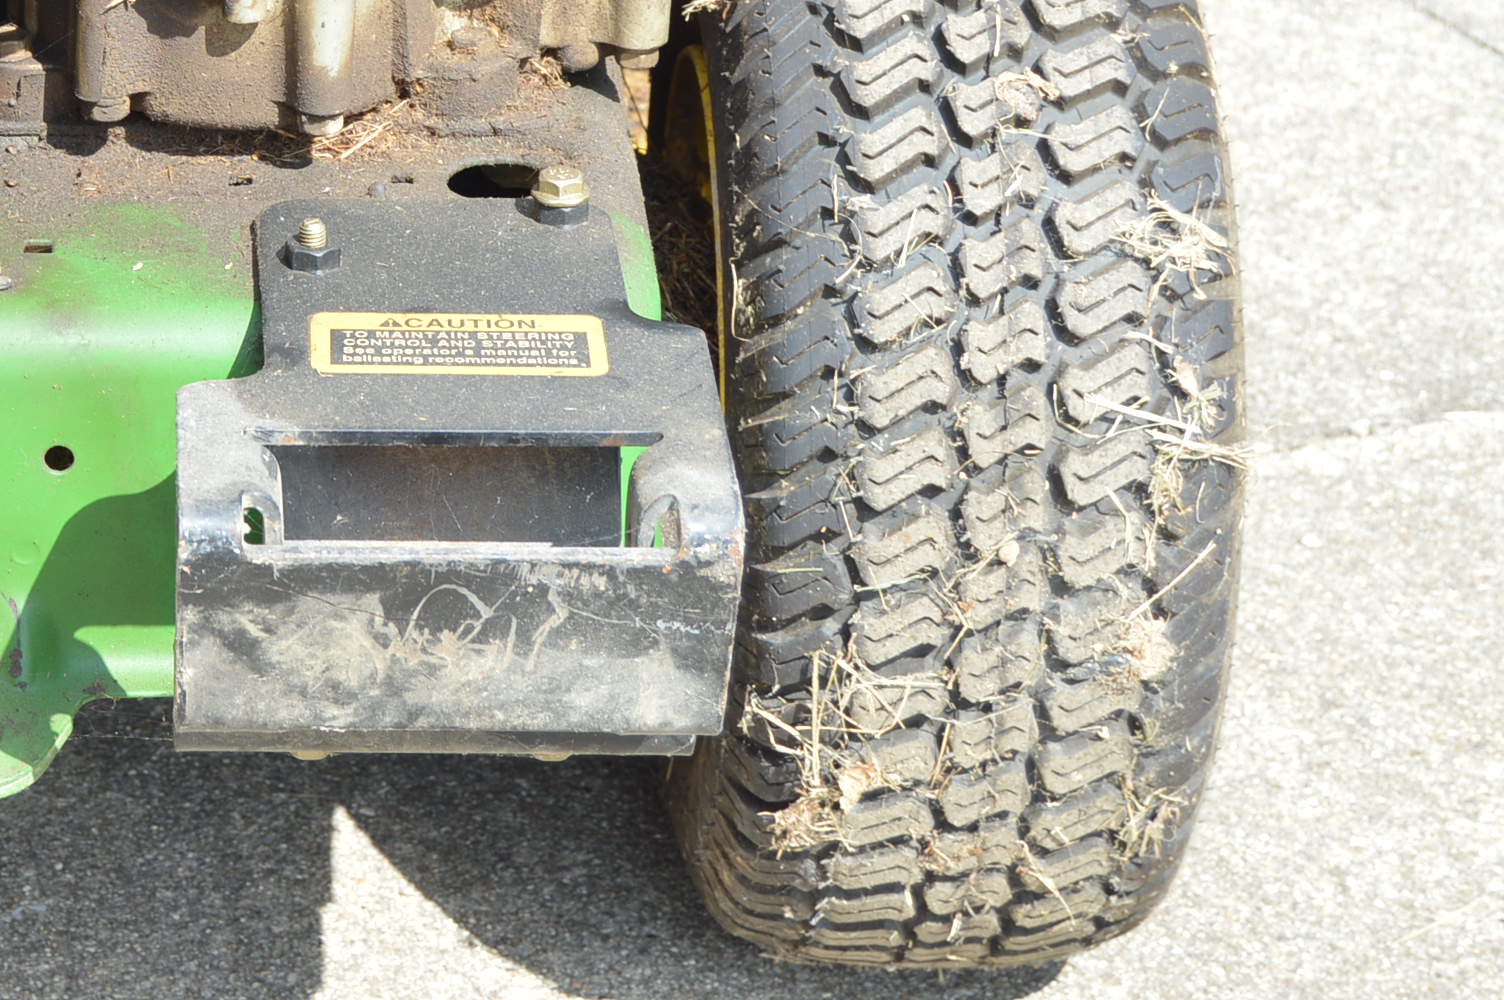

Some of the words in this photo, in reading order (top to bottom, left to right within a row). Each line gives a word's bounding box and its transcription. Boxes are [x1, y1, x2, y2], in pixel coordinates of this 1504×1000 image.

[404, 317, 536, 330] CAUTION
[343, 330, 368, 338] TO
[375, 331, 469, 339] MAINTAIN
[476, 332, 575, 341] STEERING
[343, 338, 432, 347] CONTROL
[437, 339, 476, 348] AND
[481, 340, 575, 349] STABILITY
[343, 346, 375, 354] See
[381, 347, 474, 356] operator's
[480, 348, 546, 357] manual
[551, 349, 577, 357] for
[342, 354, 424, 364] ballasting
